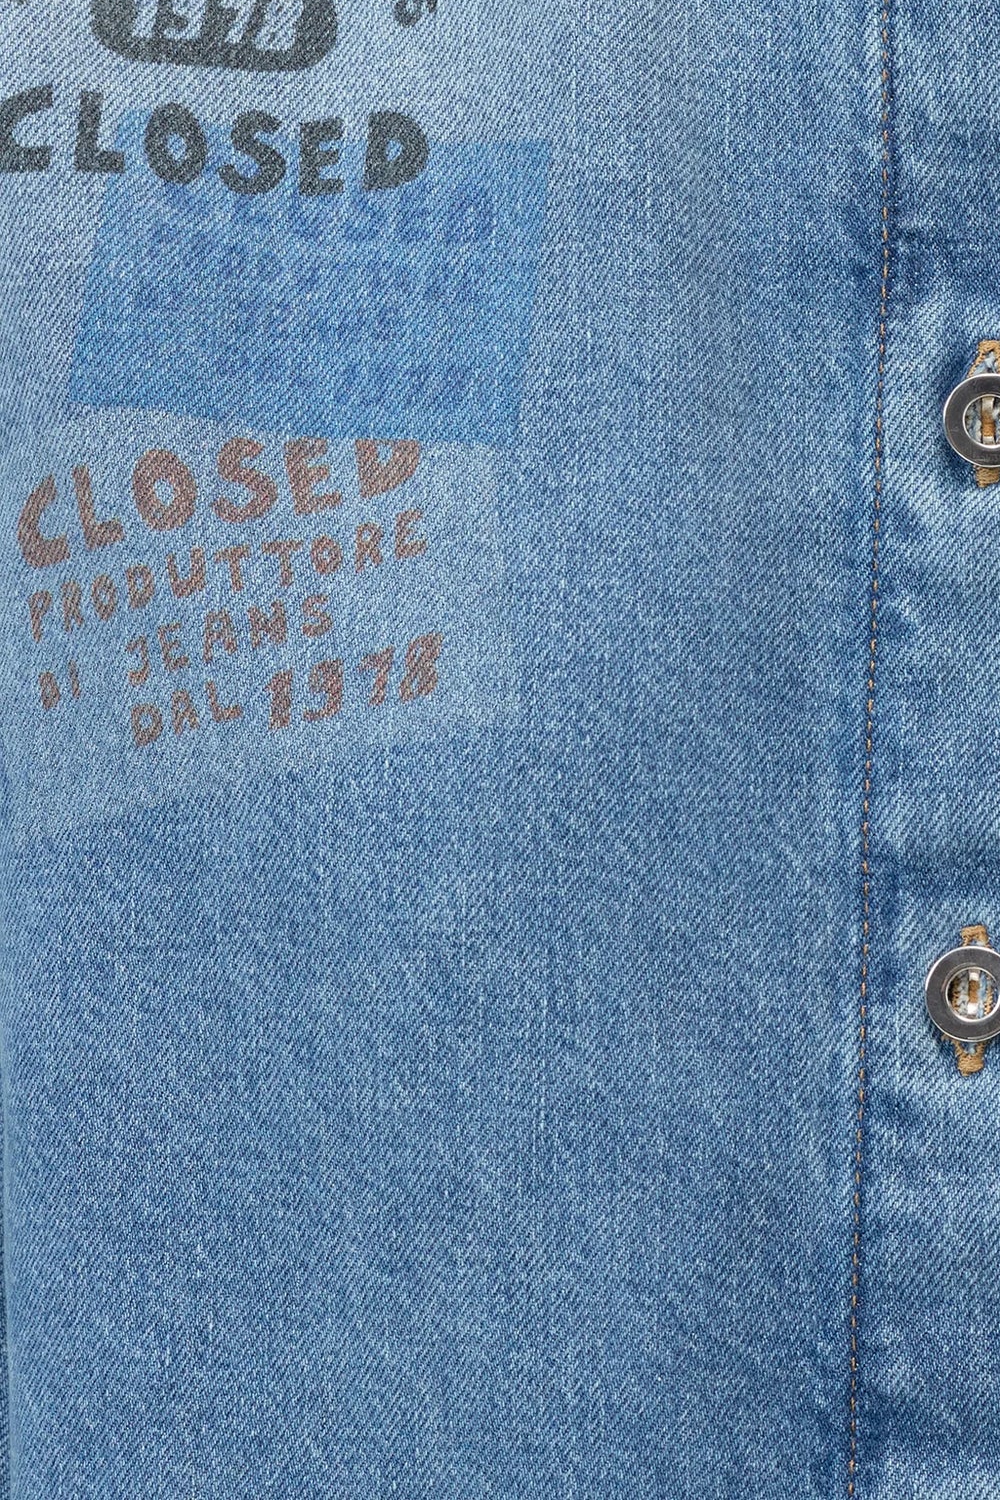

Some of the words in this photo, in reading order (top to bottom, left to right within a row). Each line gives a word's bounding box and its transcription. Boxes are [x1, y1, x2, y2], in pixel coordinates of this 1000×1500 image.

[0, 84, 430, 196] CLOSED
[16, 437, 422, 569] CLOSED
[28, 508, 429, 643] PRODUTTORE
[38, 659, 83, 711] DI
[126, 593, 334, 688] JEANS
[130, 680, 245, 748] DAL
[263, 632, 444, 731] 1978
